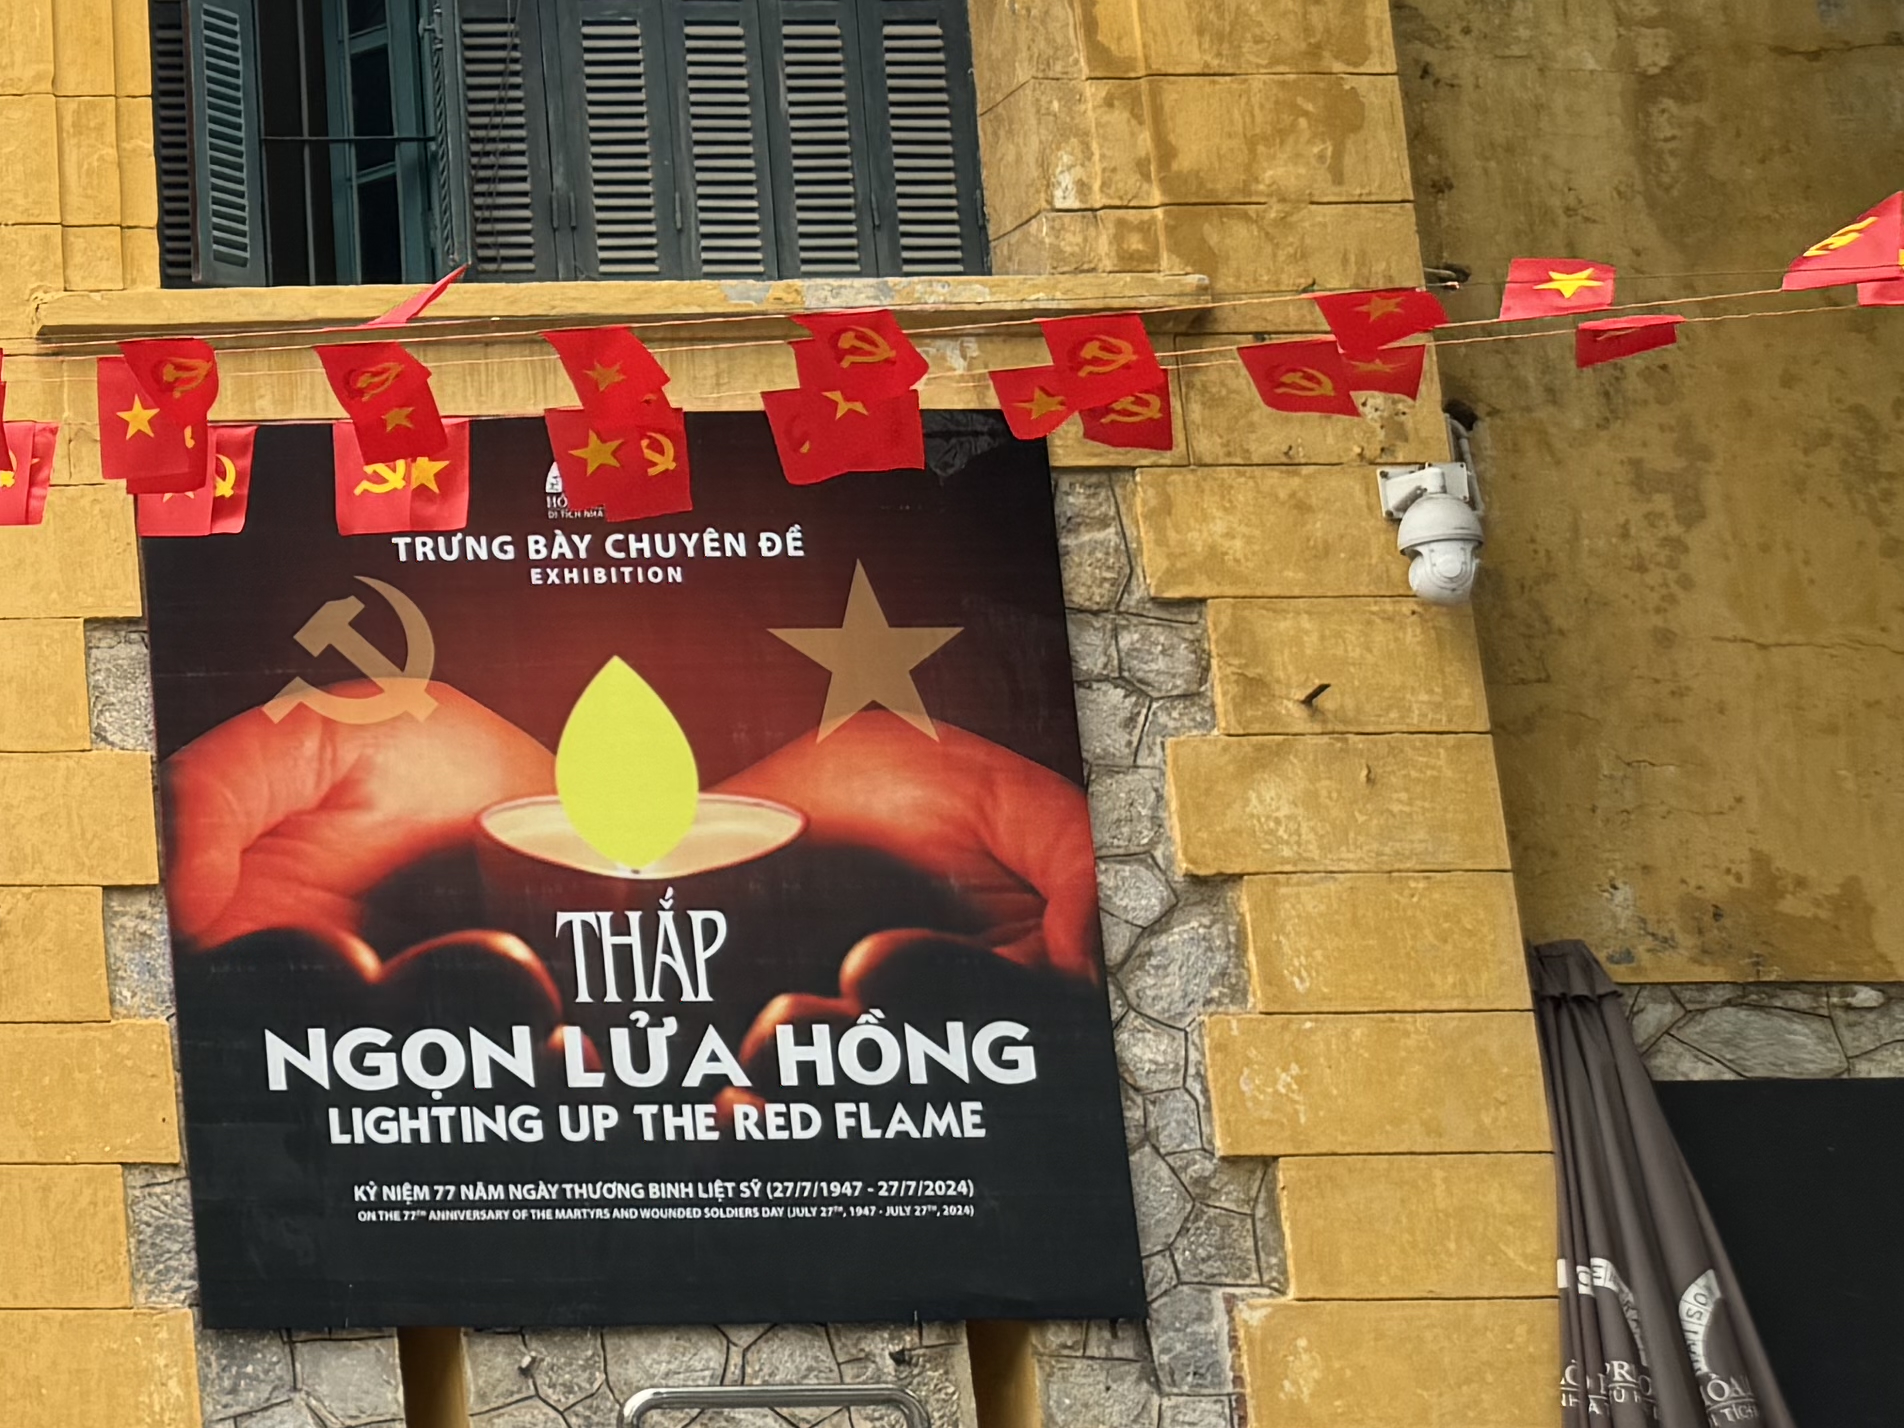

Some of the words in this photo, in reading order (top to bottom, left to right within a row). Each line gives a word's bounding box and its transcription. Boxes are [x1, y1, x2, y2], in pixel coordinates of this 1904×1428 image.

[392, 532, 514, 563] TRƯNG
[528, 529, 592, 560] BÀY
[605, 526, 747, 558] CHUYÊN
[759, 524, 805, 557] ĐỀ
[531, 566, 683, 585] EXHIBITION
[555, 887, 727, 1004] THẮP
[264, 1024, 533, 1100] NGỌN
[565, 1011, 752, 1088] LỬA
[774, 1008, 1036, 1086] HỒNG
[328, 1104, 543, 1145] LIGHTING
[559, 1105, 620, 1142] UP
[633, 1104, 720, 1141] THE
[735, 1103, 822, 1140] RED
[836, 1102, 985, 1139] FLAME
[382, 1182, 430, 1205] NIỆM
[434, 1184, 456, 1201] 77
[460, 1182, 504, 1201] NĂM
[509, 1181, 559, 1200] NGÀY
[562, 1181, 644, 1200] THƯƠNG
[649, 1182, 693, 1199] BINH
[698, 1179, 735, 1202] LIỆT
[766, 1180, 863, 1199] (27/7/1947
[877, 1179, 974, 1198] 27/7/2024)
[358, 1210, 377, 1222] ON
[378, 1210, 401, 1222] THE
[428, 1209, 509, 1221] ANNIVERSARY
[512, 1209, 528, 1220] OF
[530, 1209, 553, 1220] THE
[555, 1208, 610, 1220] MARTYRS
[612, 1208, 638, 1219] AND
[639, 1207, 701, 1219] WOUNDED
[704, 1207, 759, 1219] SOLDIERS
[761, 1207, 784, 1218] DAY
[787, 1206, 818, 1219] (JULY
[849, 1205, 876, 1217] 1947
[885, 1205, 911, 1217] JULY
[942, 1205, 975, 1218] 2024)
